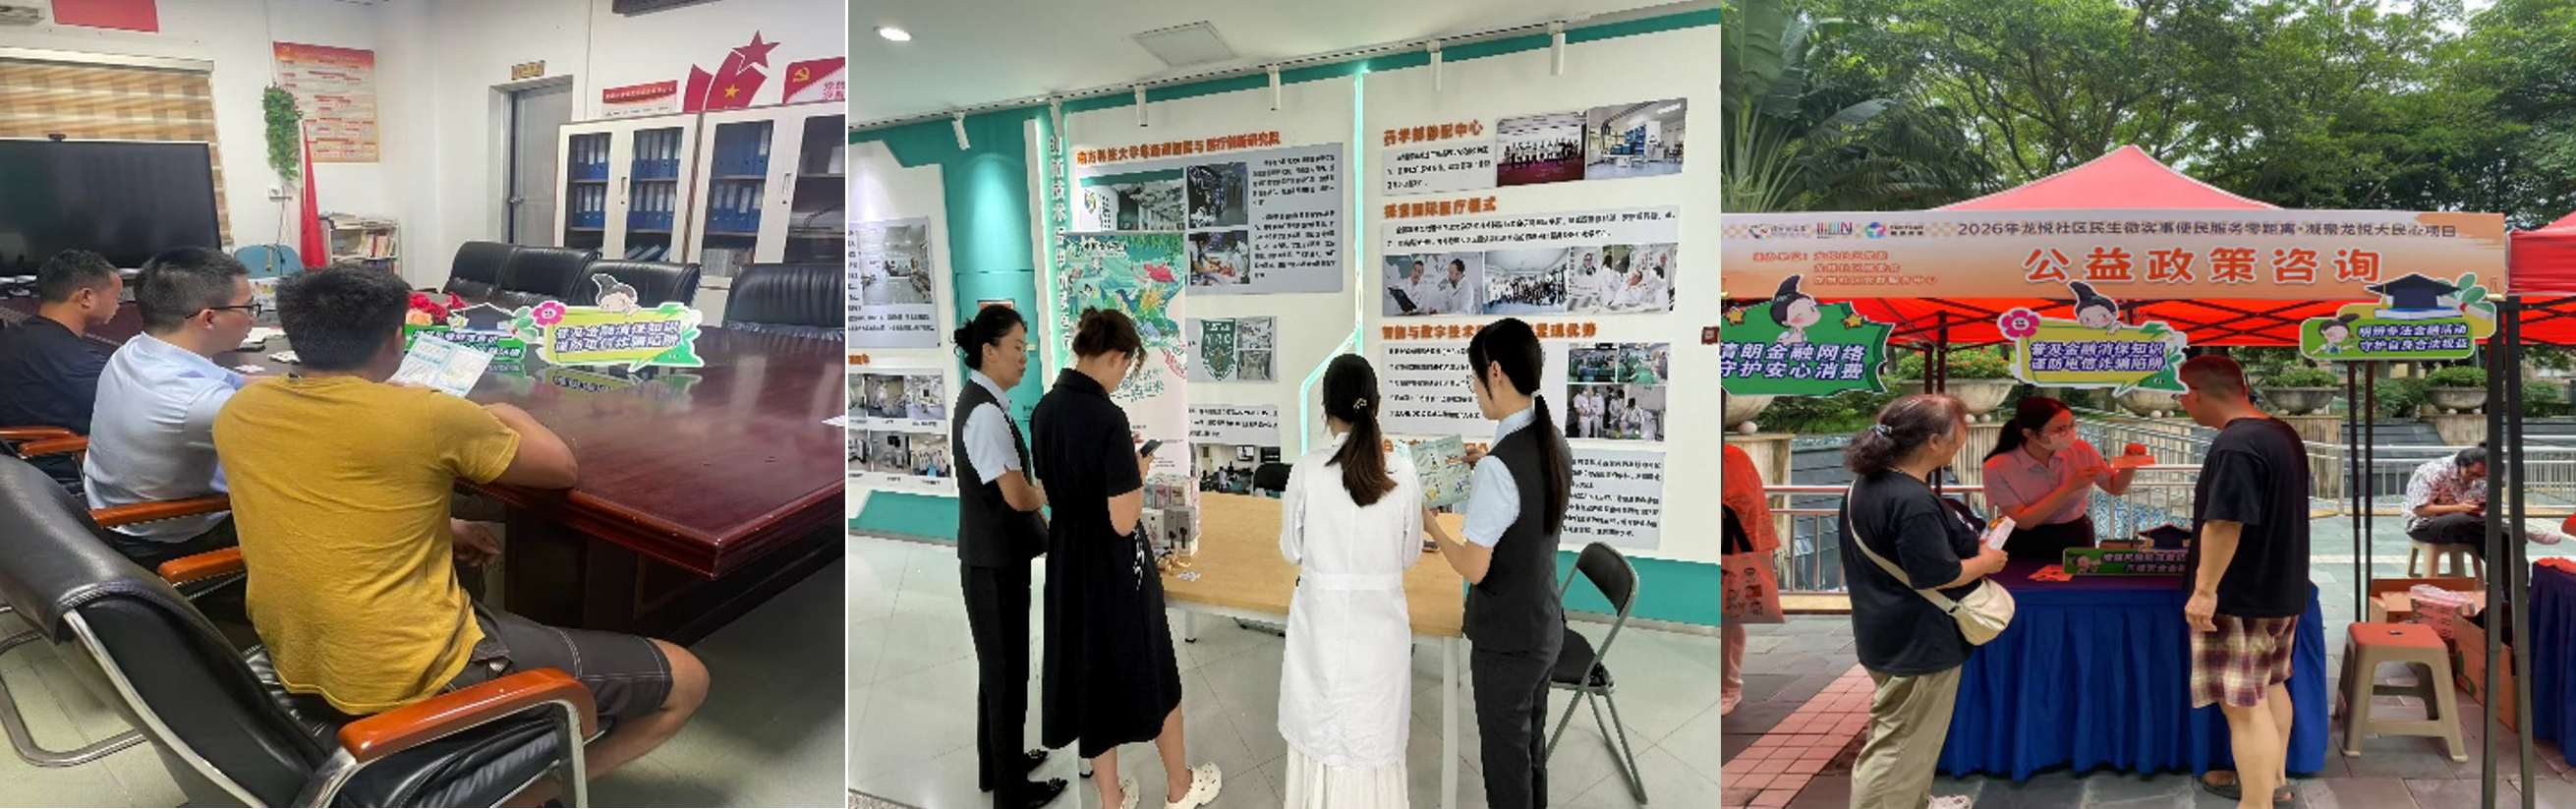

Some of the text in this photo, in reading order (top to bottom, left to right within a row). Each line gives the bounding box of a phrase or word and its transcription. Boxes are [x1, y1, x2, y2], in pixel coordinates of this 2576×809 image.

[2023, 247, 2381, 283] 公益政策咨询
[1721, 343, 1865, 362] 清朗金融网络
[2030, 341, 2165, 356] 普及金融消保知识
[2359, 338, 2469, 352] 守护自身合法权益
[1721, 361, 1864, 379] 守护安心消费
[2030, 356, 2165, 371] 谨防电信诈骗陷阱
